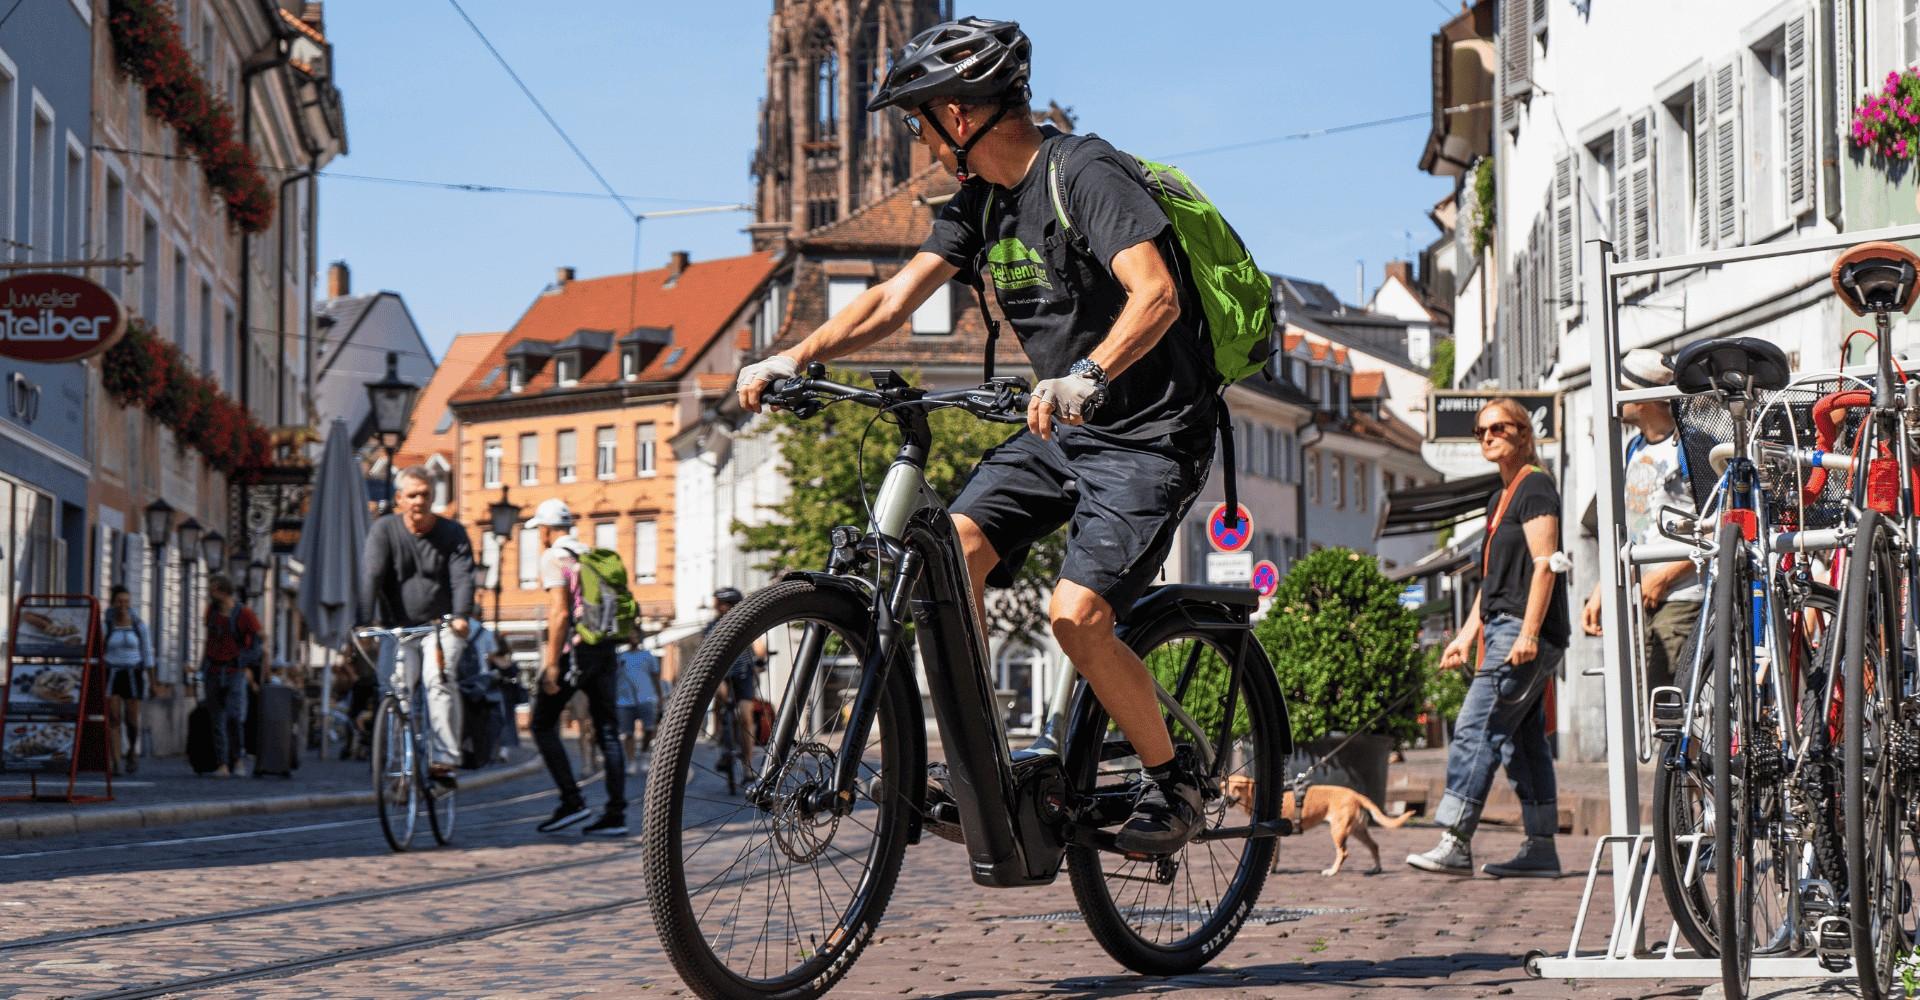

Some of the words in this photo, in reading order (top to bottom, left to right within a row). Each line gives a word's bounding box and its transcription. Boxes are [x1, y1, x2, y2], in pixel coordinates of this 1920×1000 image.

[954, 54, 978, 74] uvex
[3, 287, 81, 308] Juwelier
[1201, 900, 1248, 954] MAXXIS
[812, 920, 869, 991] MAXXIS
